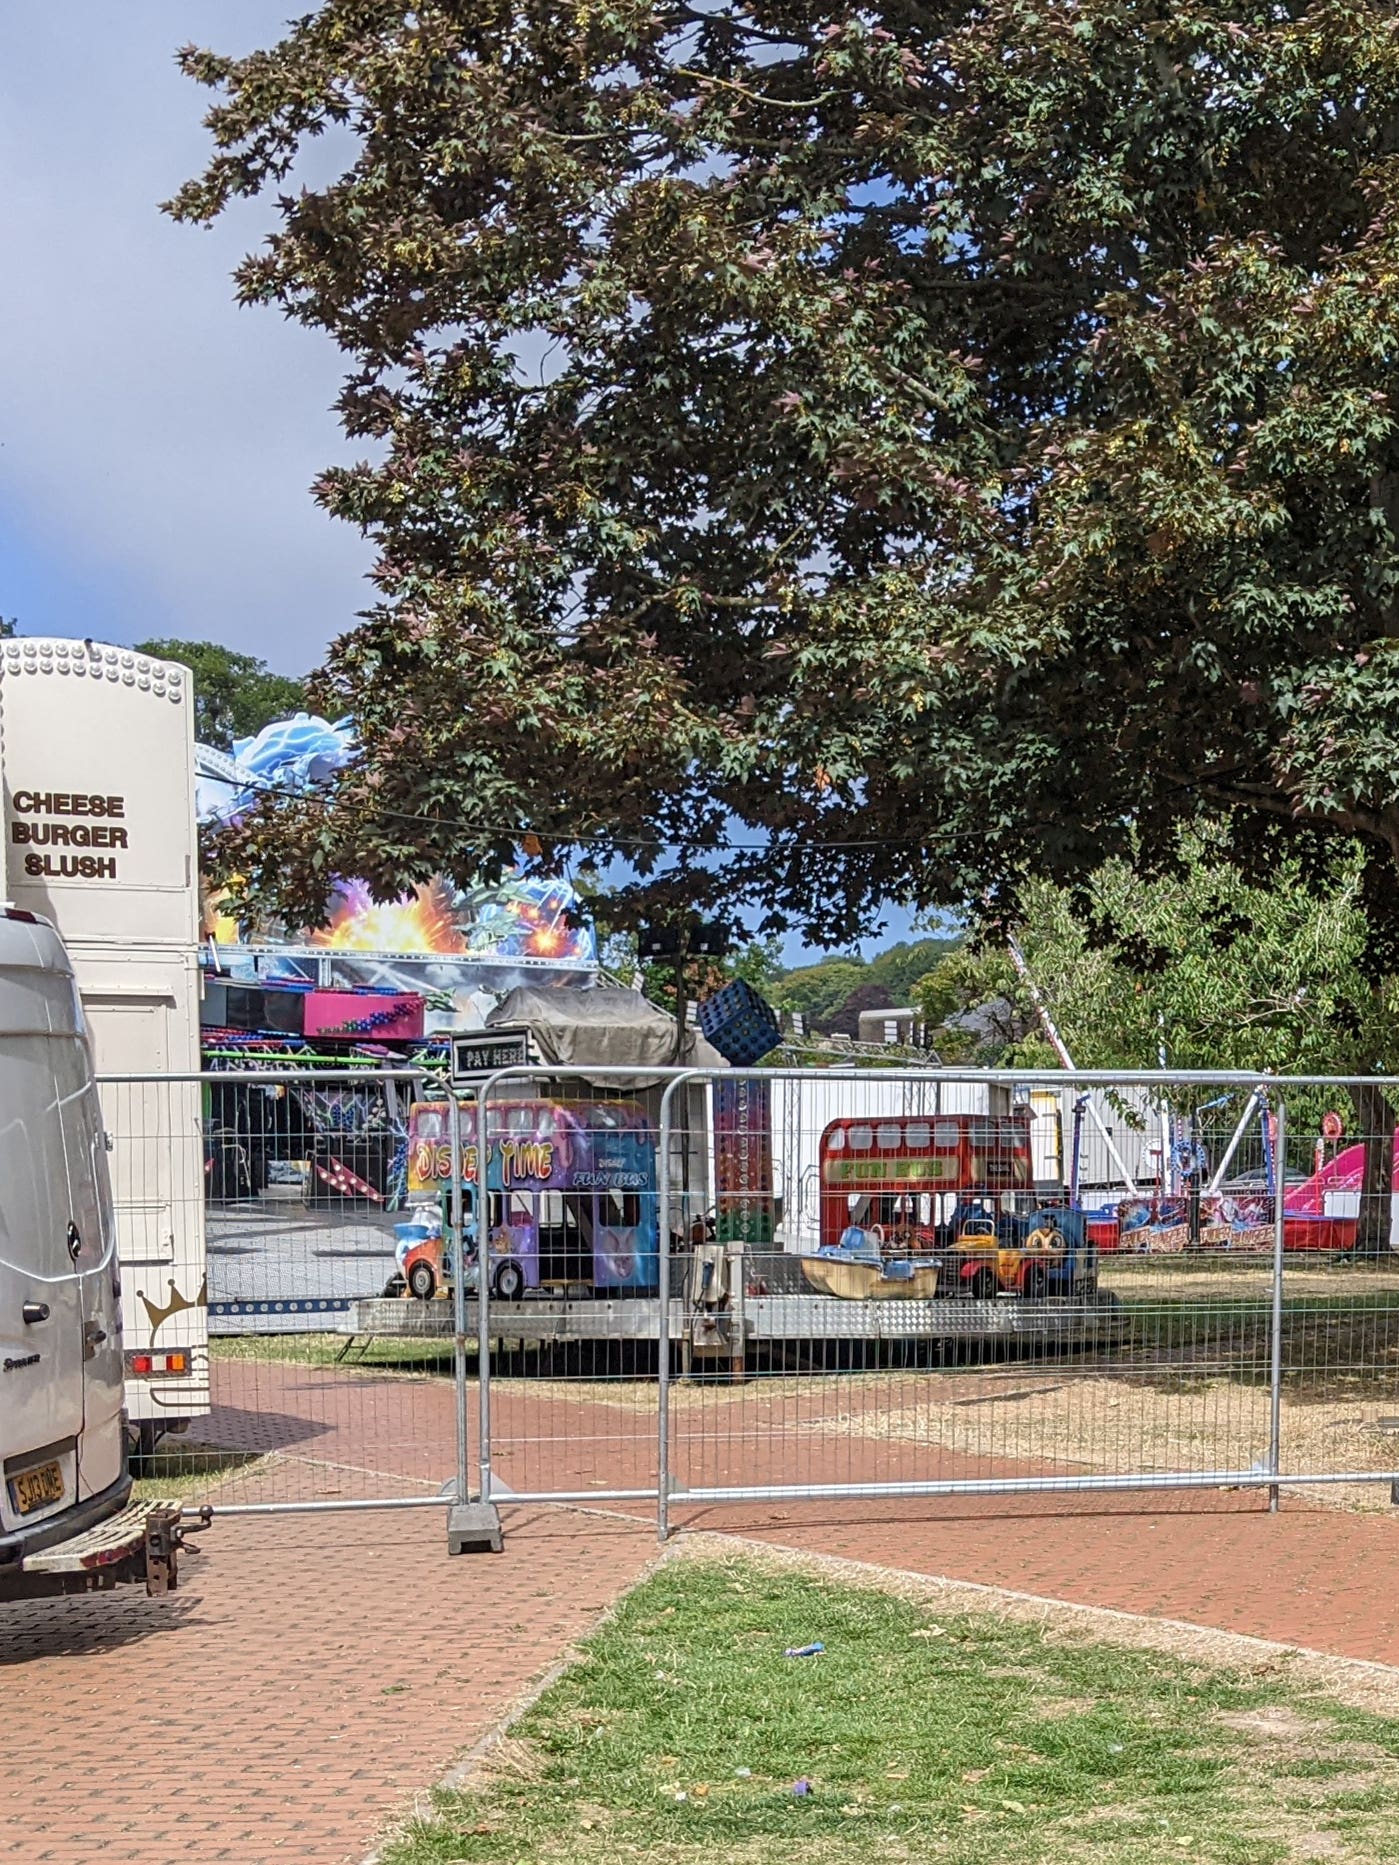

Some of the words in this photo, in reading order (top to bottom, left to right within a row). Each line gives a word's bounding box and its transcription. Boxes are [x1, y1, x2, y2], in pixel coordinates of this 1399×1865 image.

[13, 790, 125, 818] CHEESE
[11, 822, 128, 849] BURGER
[24, 853, 116, 879] SLUSH
[466, 1050, 490, 1068] PAY
[492, 1046, 524, 1065] HERE
[500, 1139, 554, 1187] TIME
[839, 1161, 888, 1179] FUN
[895, 1159, 943, 1178] BUS
[572, 1171, 611, 1186] FUN
[613, 1171, 649, 1188] BUS
